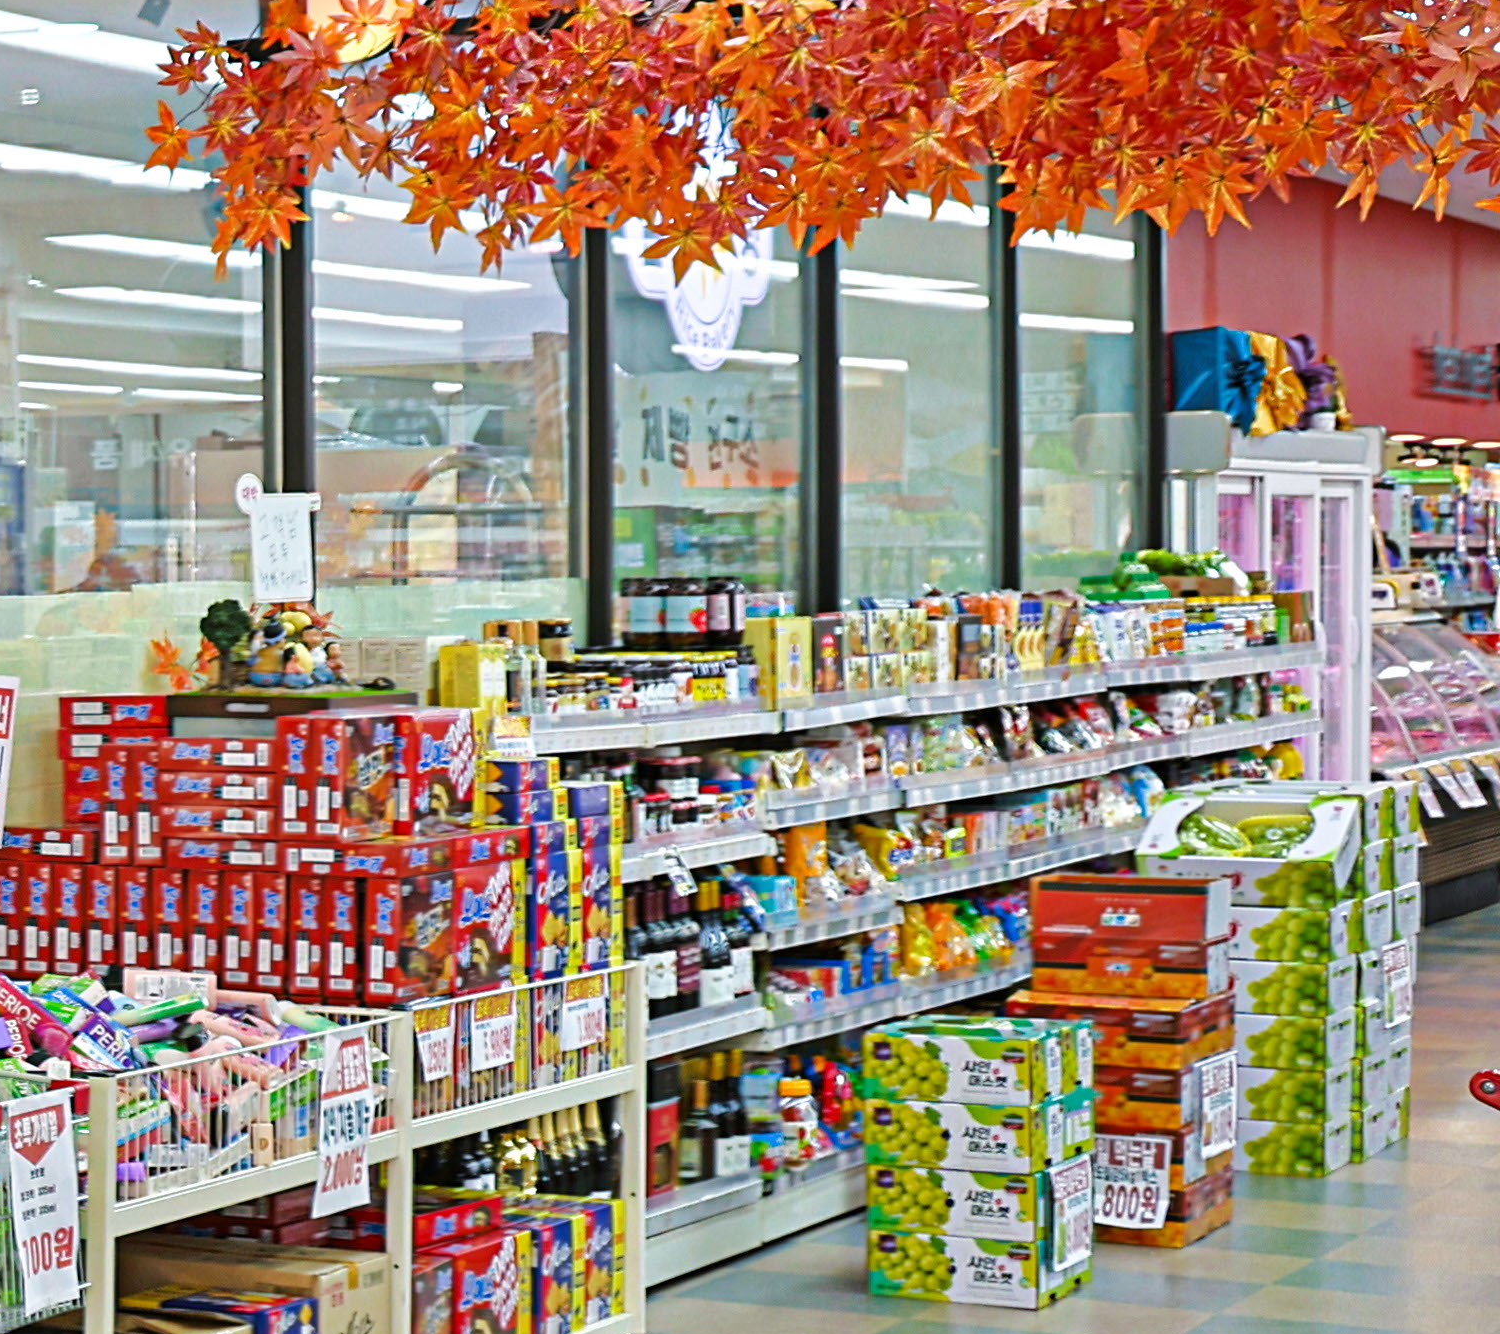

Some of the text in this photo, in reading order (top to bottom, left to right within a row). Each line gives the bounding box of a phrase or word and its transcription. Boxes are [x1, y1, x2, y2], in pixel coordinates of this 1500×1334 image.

[4, 1019, 27, 1060] PERIO
[89, 1023, 131, 1066] PERIO
[962, 1059, 992, 1075] 샤인
[968, 1075, 1008, 1088] 머스켓
[962, 1126, 991, 1140] 샤인
[968, 1141, 1008, 1155] 머스켓
[965, 1189, 994, 1204] 샤인
[971, 1204, 1011, 1219] 머스켓
[22, 1225, 75, 1279] 100원
[967, 1255, 997, 1270] 샤인
[973, 1271, 1013, 1285] 머스켓
